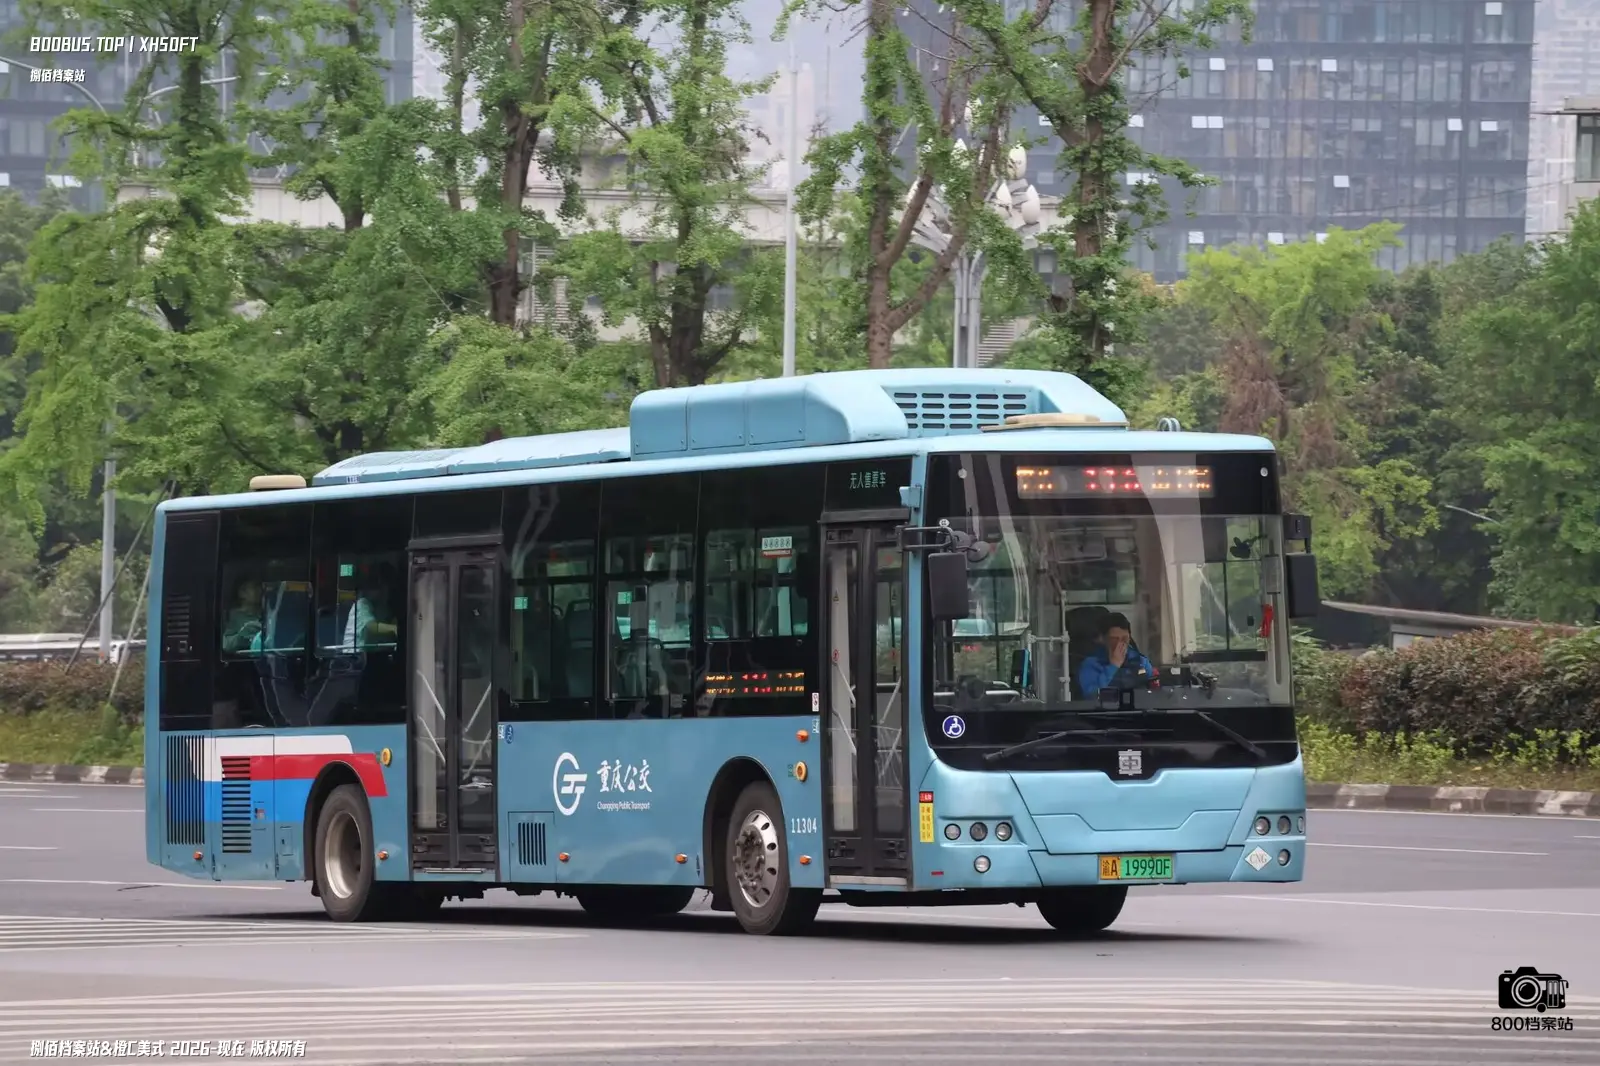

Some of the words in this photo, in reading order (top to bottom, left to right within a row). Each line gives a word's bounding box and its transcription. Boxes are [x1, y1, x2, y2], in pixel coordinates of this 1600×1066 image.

[849, 470, 887, 489] 无人售票车
[596, 758, 653, 793] 重庆公交
[791, 817, 818, 834] 11304
